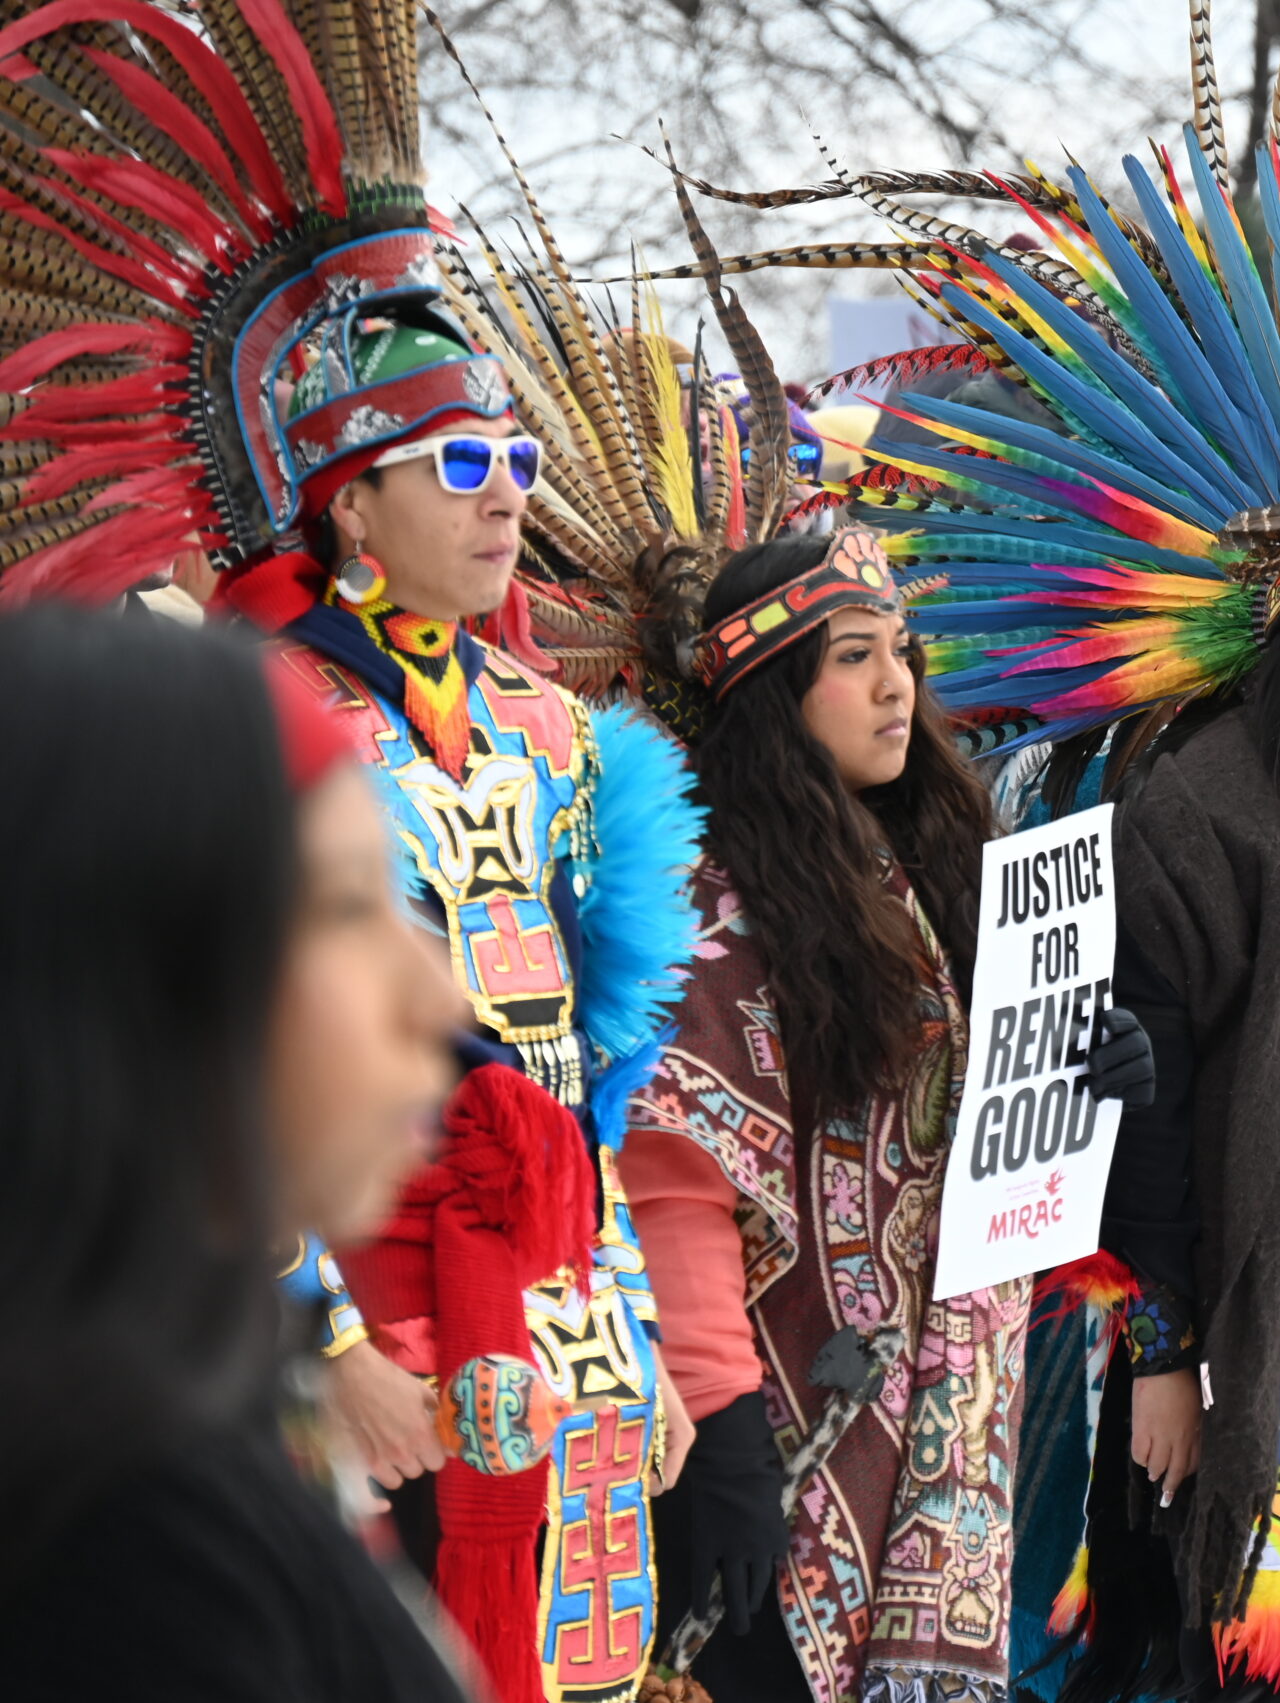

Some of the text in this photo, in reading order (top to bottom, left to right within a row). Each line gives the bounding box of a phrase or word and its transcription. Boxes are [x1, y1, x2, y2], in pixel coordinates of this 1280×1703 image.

[997, 833, 1103, 929] JUSTICE
[1031, 922, 1080, 989] FOR
[970, 1074, 1099, 1182] GOOD
[986, 1197, 1064, 1244] MIRAC
